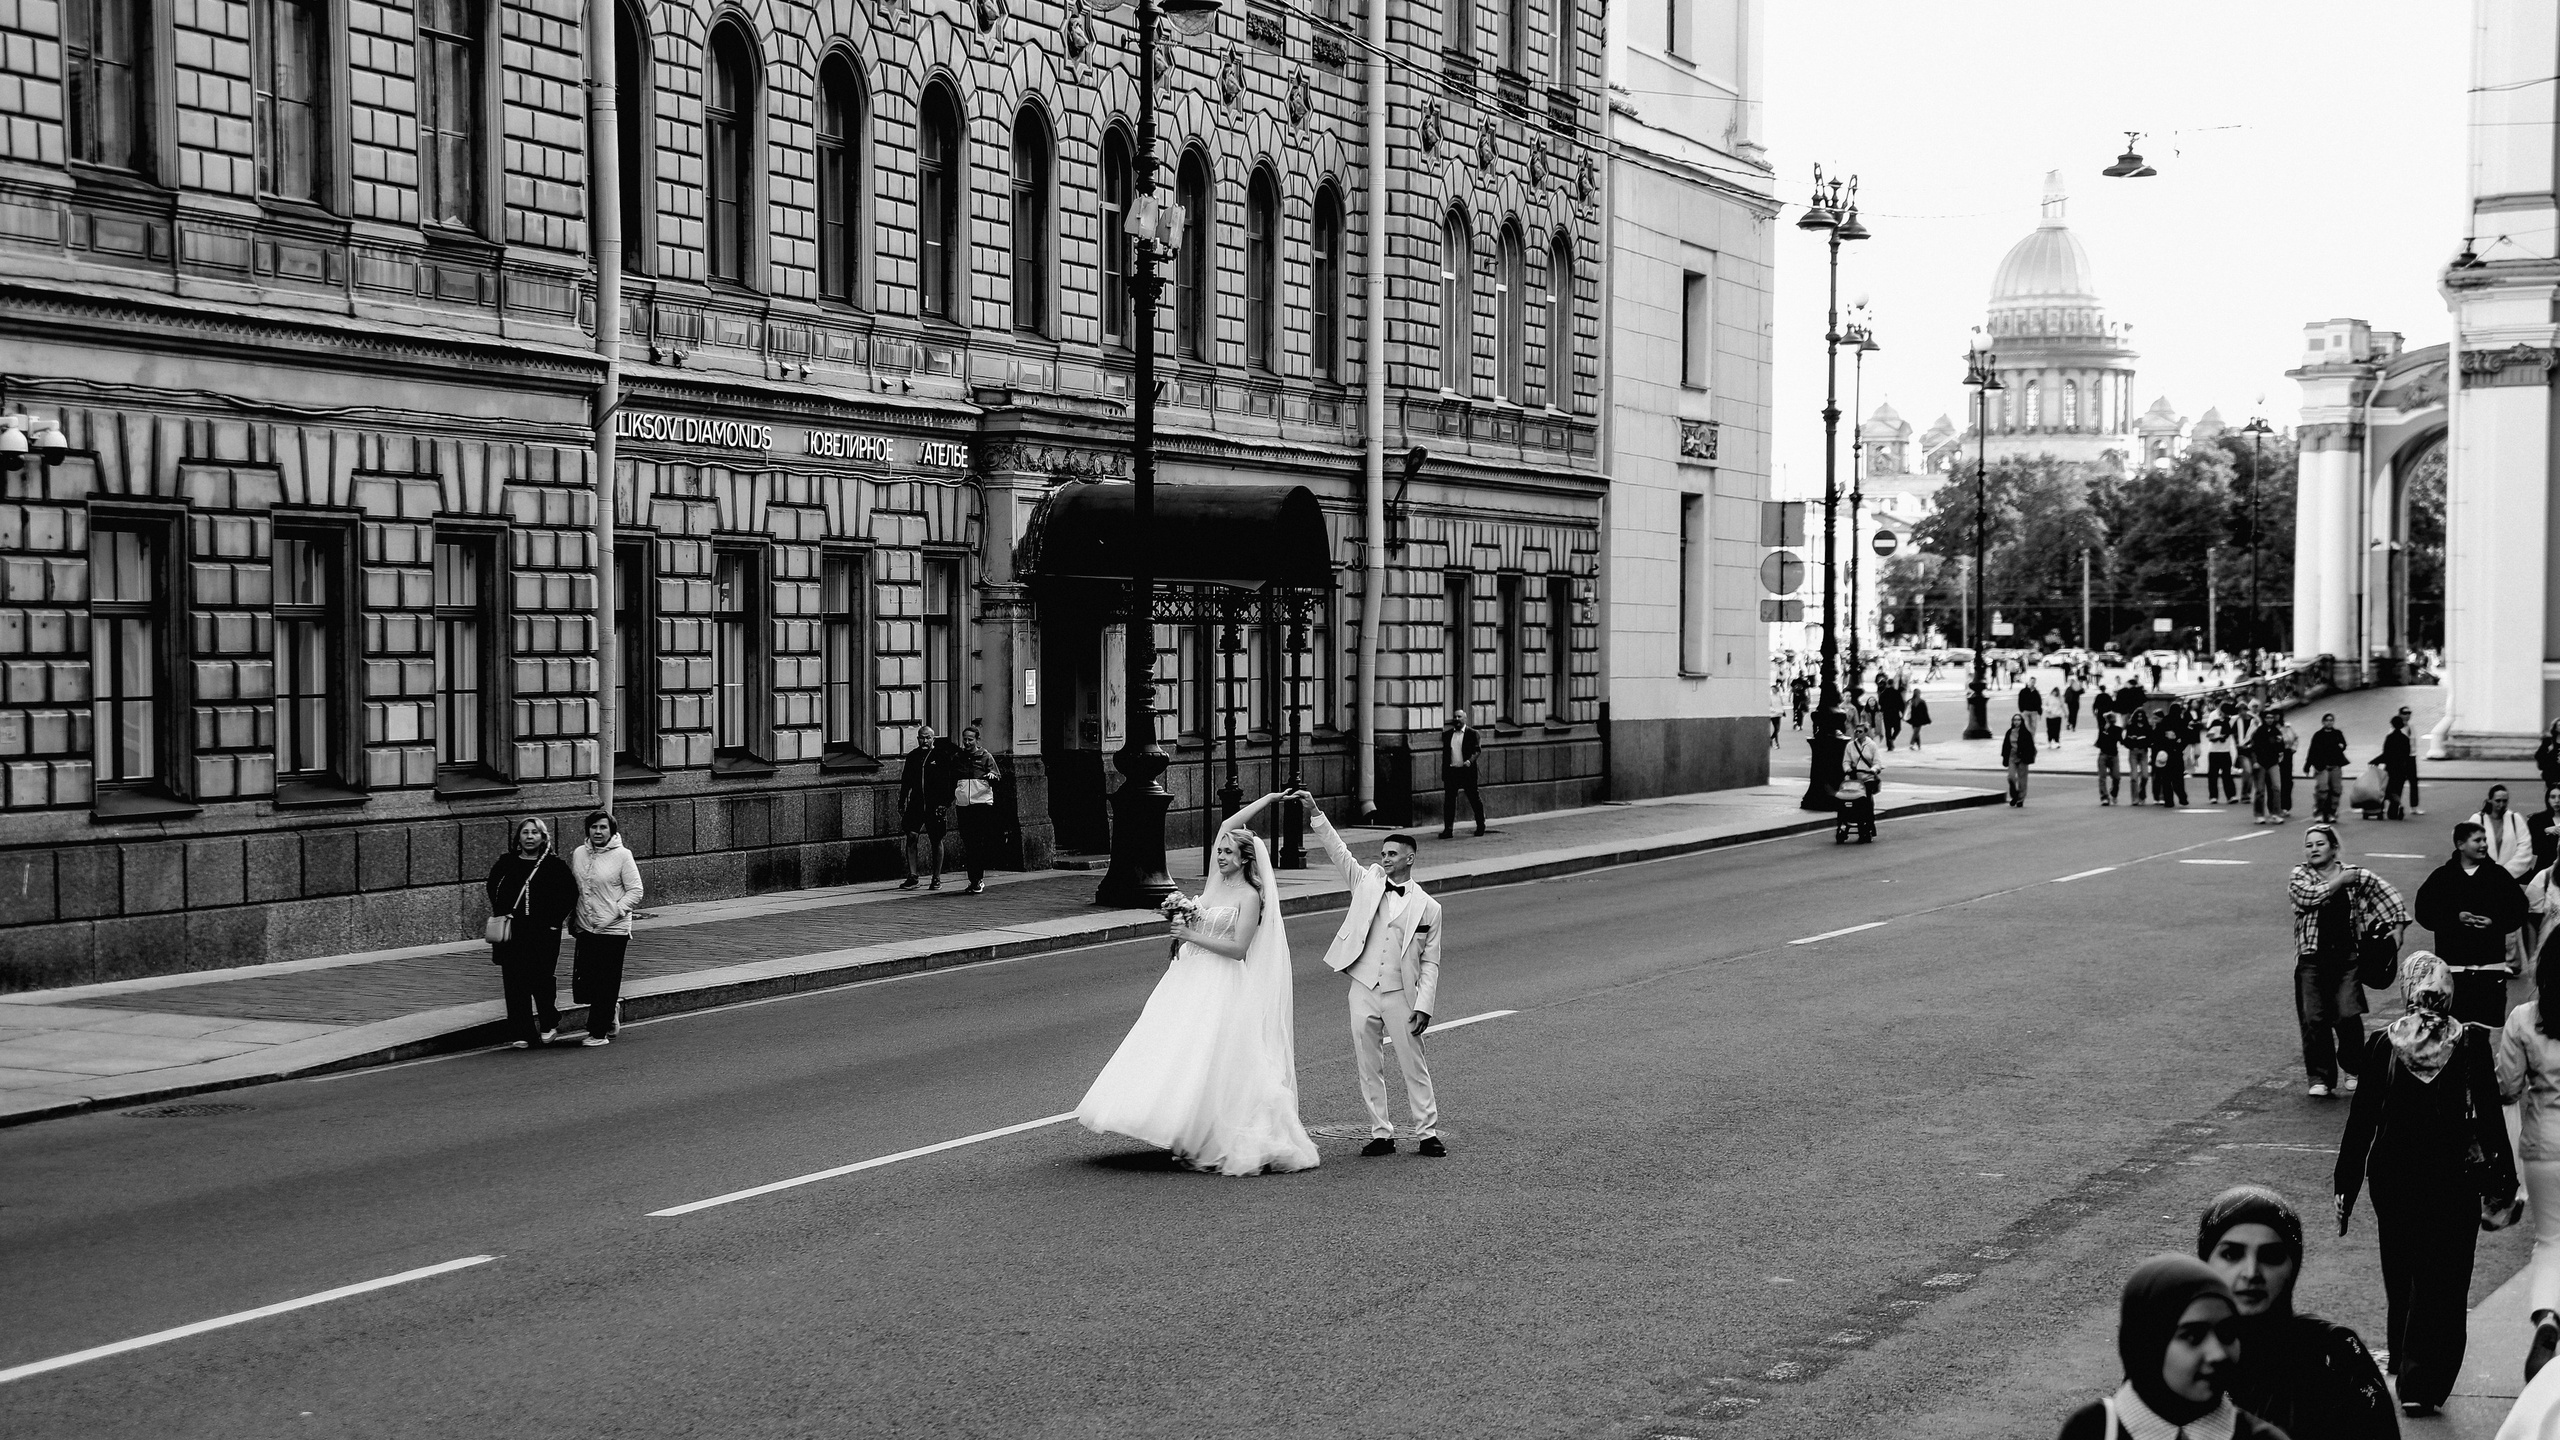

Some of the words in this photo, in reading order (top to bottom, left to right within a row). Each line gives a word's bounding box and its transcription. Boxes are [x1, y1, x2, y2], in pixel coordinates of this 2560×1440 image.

[686, 418, 773, 450] DIAMONDS
[810, 431, 894, 461] ЮВЕЛИРНОЕ
[923, 442, 969, 468] АТЕЛЬЕ
